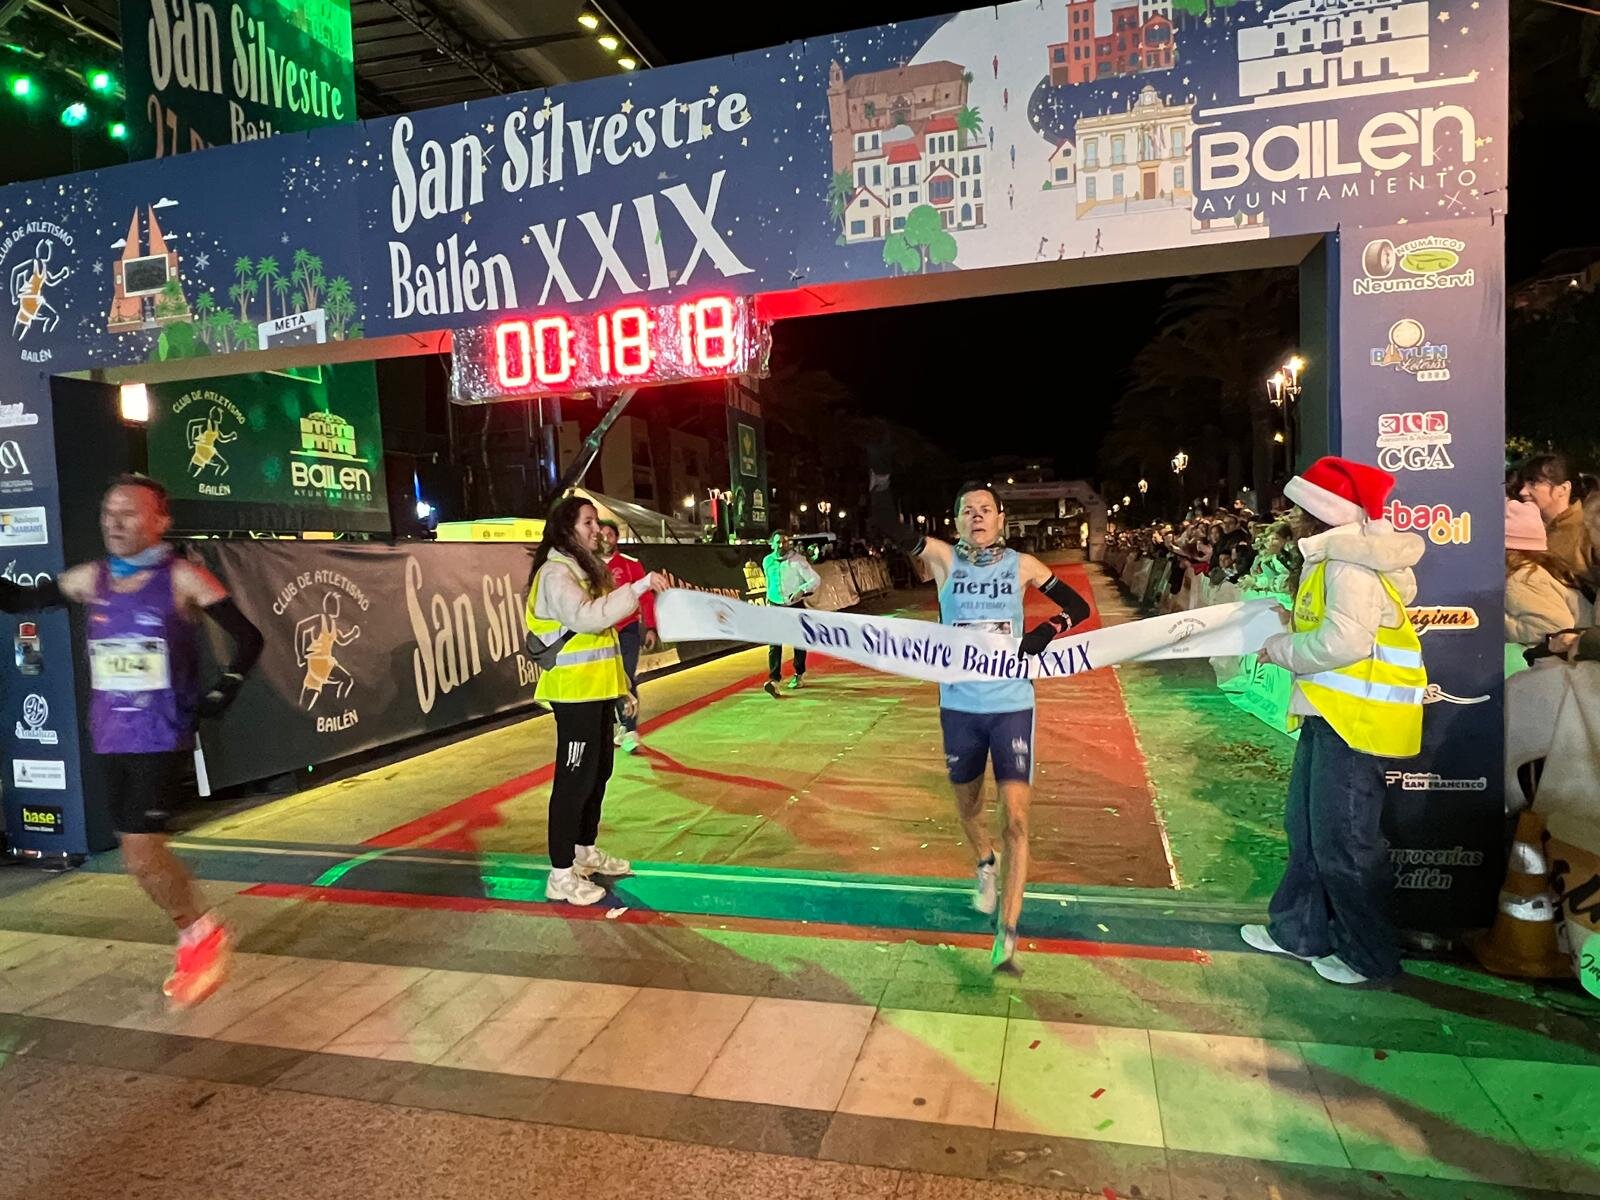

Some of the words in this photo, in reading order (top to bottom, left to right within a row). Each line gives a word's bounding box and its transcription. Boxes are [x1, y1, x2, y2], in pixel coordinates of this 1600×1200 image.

[230, 3, 345, 120] Silvestre
[391, 116, 484, 234] San
[501, 93, 752, 192] Silvestre
[1201, 169, 1477, 214] AYUNTAMIENTO
[0, 237, 13, 265] LUB
[12, 226, 25, 242] DE
[26, 221, 74, 246] ATLETISMO
[388, 233, 518, 319] Bailén
[529, 170, 755, 306] XXIX
[1397, 237, 1465, 256] NEUMÁTICOS
[1354, 269, 1475, 295] NeumaServi
[274, 315, 306, 332] META
[21, 349, 52, 363] BAILÉN
[173, 394, 192, 413] CLUB
[191, 391, 202, 400] DE
[204, 391, 246, 424] ATLETISMO
[1378, 446, 1454, 472] CGA
[198, 483, 231, 496] BAILÉN
[1428, 512, 1472, 545] Oil
[273, 582, 297, 615] CLUB
[297, 571, 312, 588] DE
[314, 570, 370, 611] ATLETISMO
[952, 579, 1012, 599] nerja
[405, 555, 482, 714] San
[1411, 608, 1473, 632] áginas
[799, 612, 850, 647] San
[862, 623, 952, 668] Silvestre
[962, 644, 1029, 679] Bailén
[1037, 641, 1093, 679] XXIX
[316, 709, 358, 733] BAILÉN
[1403, 781, 1425, 789] SAN
[1428, 781, 1485, 789] FRANCISCO
